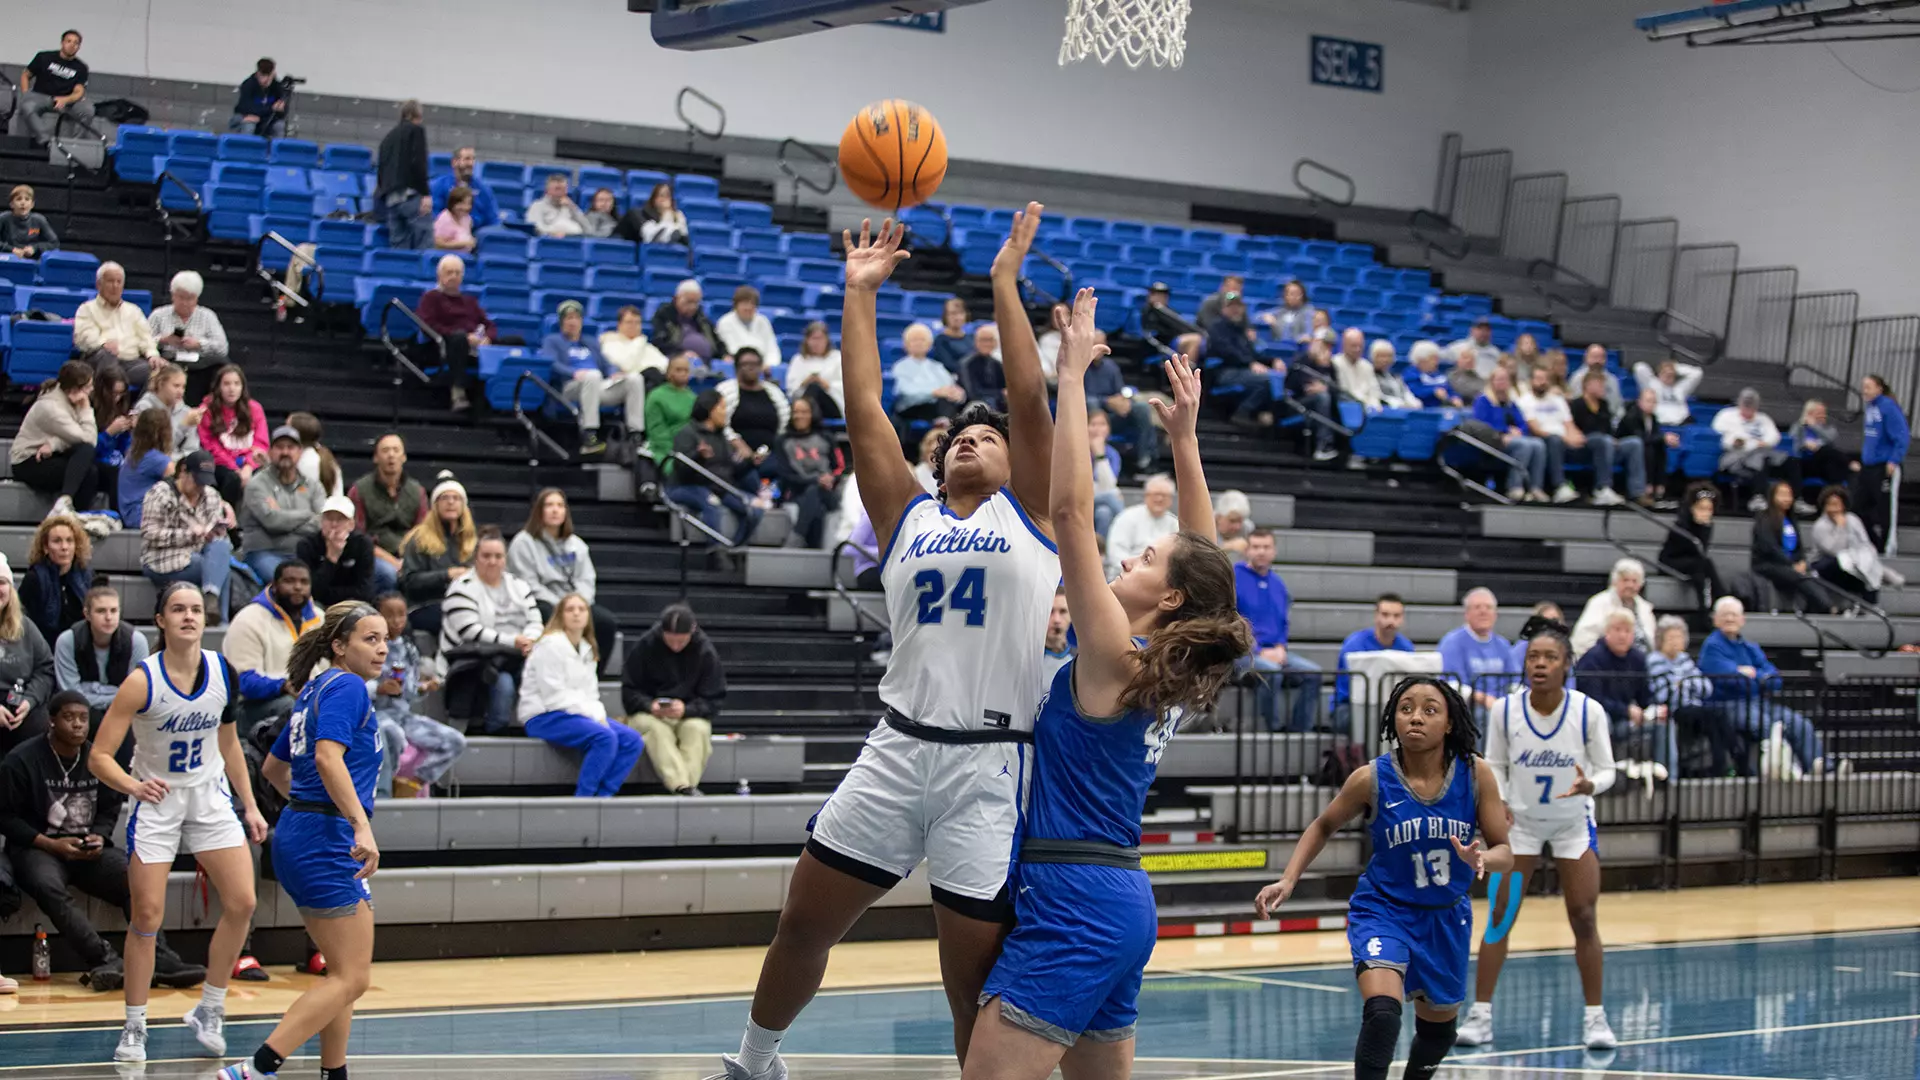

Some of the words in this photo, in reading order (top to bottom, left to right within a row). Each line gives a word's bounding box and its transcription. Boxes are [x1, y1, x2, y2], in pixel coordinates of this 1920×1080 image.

[1315, 40, 1363, 85] SEC.
[1364, 47, 1380, 88] 5
[900, 526, 1011, 563] Millikin
[914, 566, 987, 627] 24
[168, 737, 205, 773] 22
[1514, 749, 1576, 768] Millikin
[1535, 774, 1554, 804] 7
[1385, 817, 1422, 849] LADY
[1427, 816, 1471, 842] BLUES
[1411, 848, 1450, 889] 13
